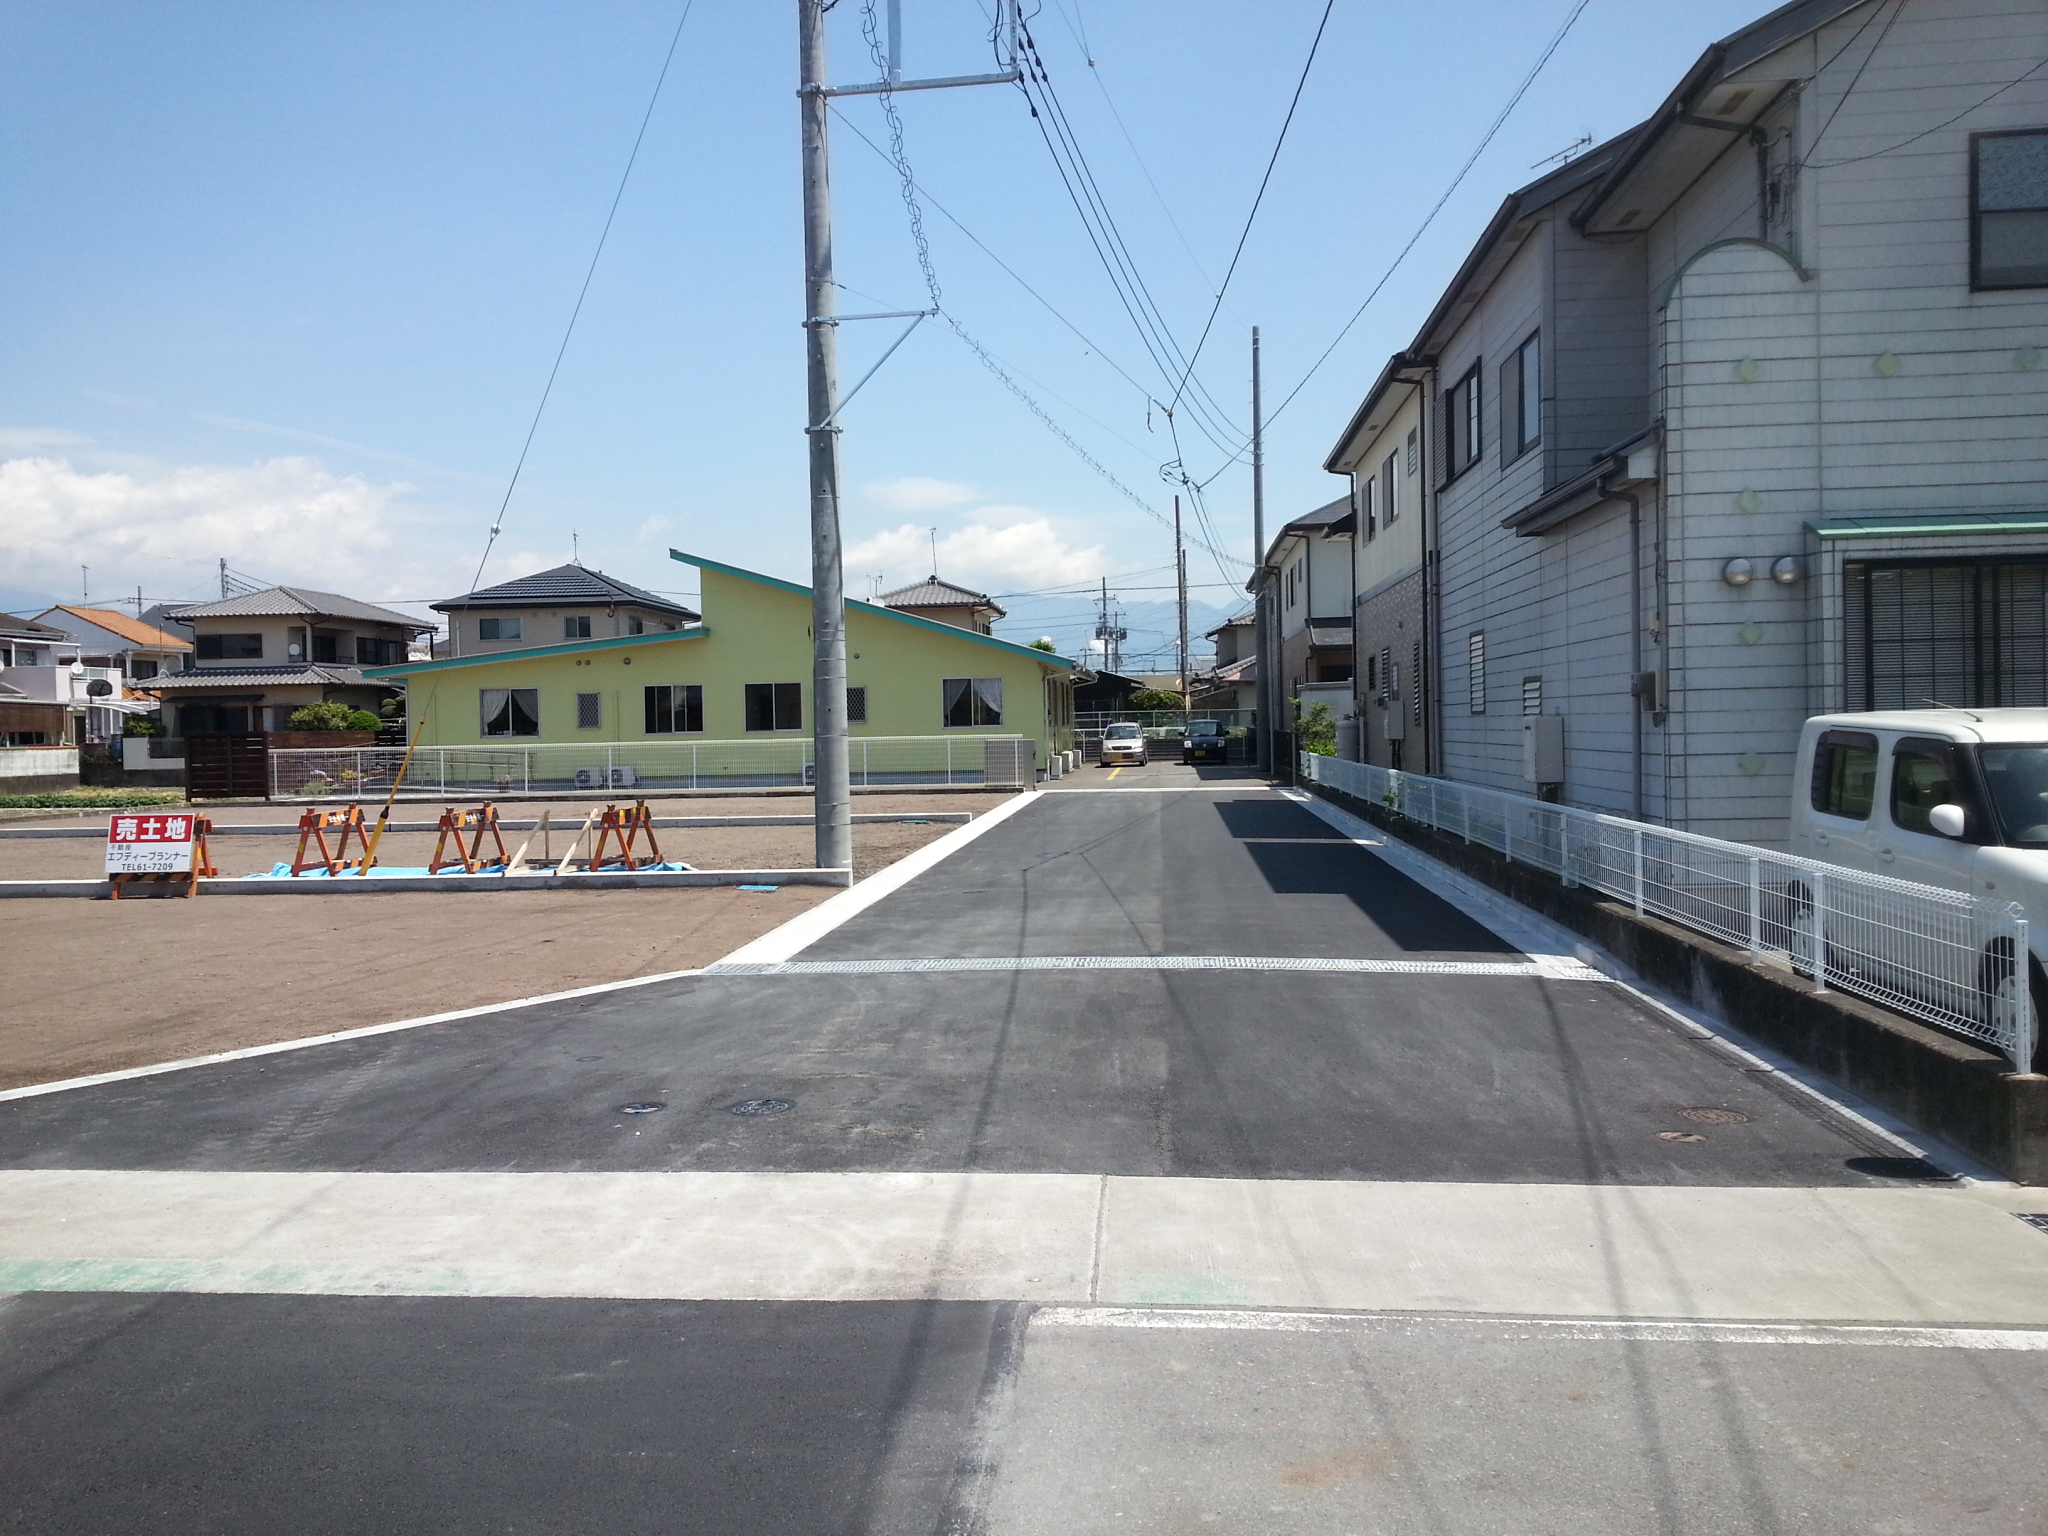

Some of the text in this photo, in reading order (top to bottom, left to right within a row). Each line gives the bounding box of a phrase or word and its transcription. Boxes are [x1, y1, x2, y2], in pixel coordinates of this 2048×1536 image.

[115, 817, 187, 841] 売土地
[121, 863, 174, 871] TEL61-7209
